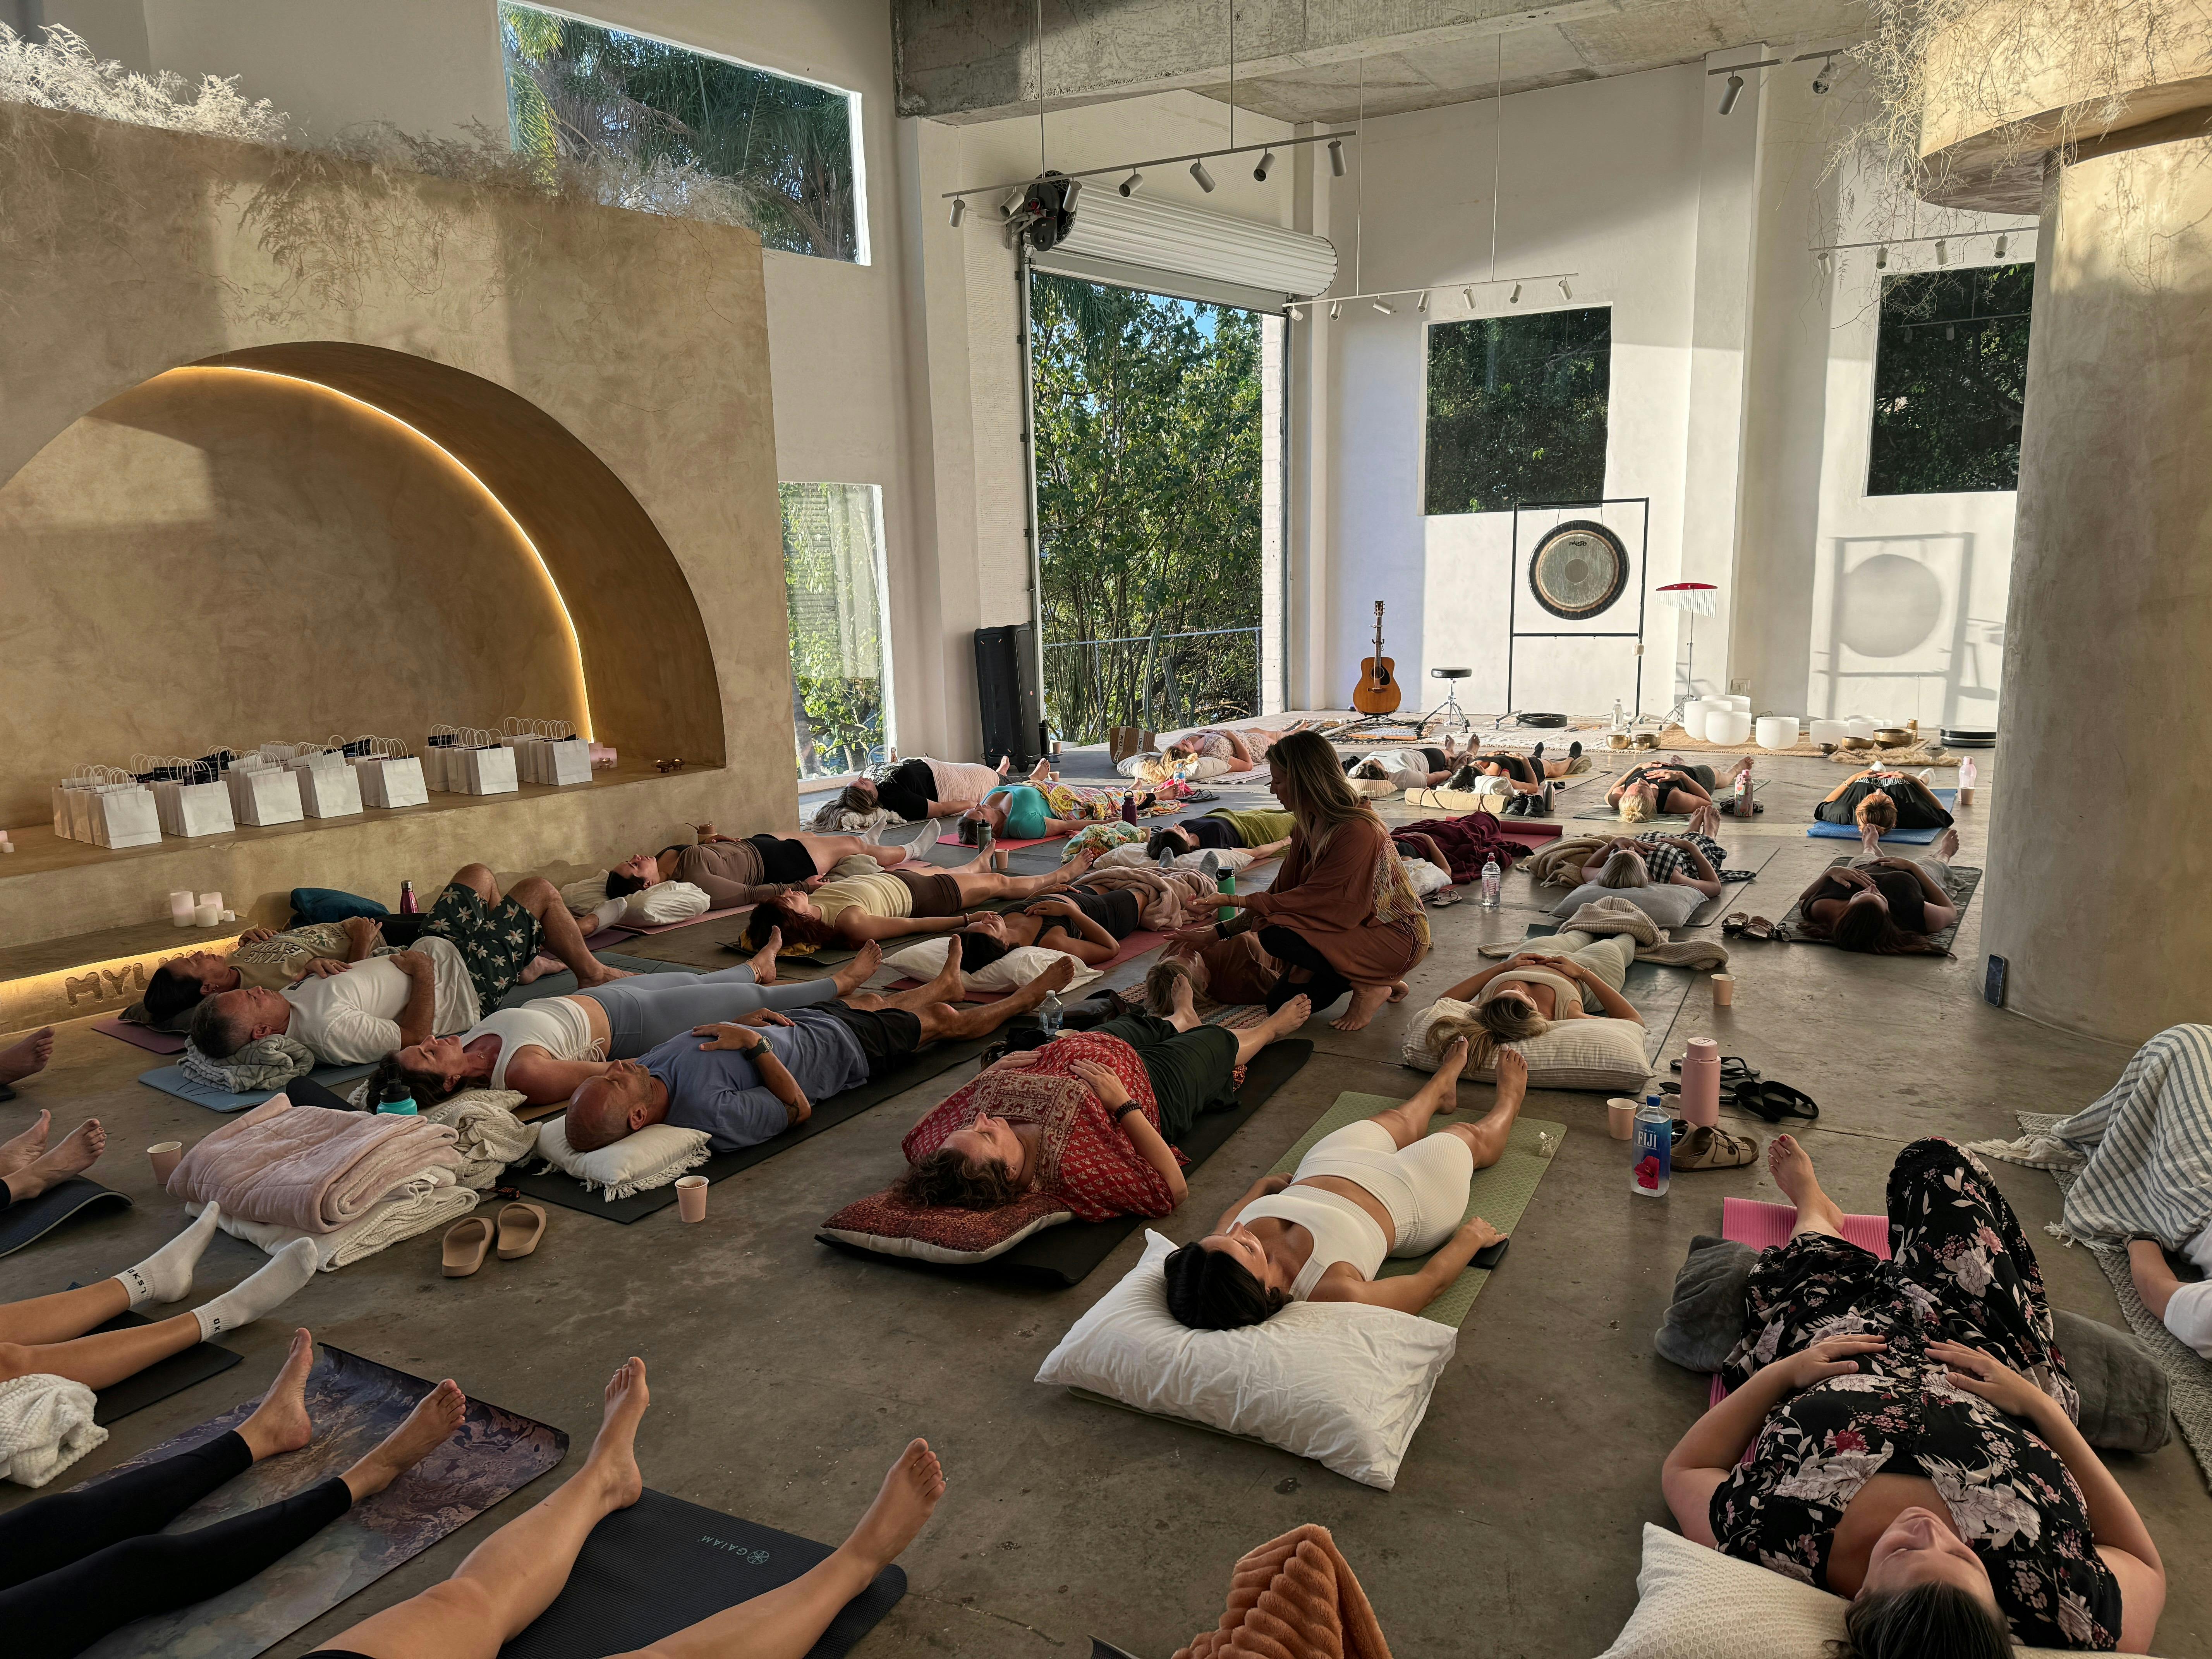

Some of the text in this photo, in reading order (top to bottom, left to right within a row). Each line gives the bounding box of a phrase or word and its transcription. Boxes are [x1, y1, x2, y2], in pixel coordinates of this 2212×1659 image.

[244, 951, 288, 964] TIME
[1638, 1131, 1657, 1148] FIJI
[701, 1535, 748, 1556] GAIAM
